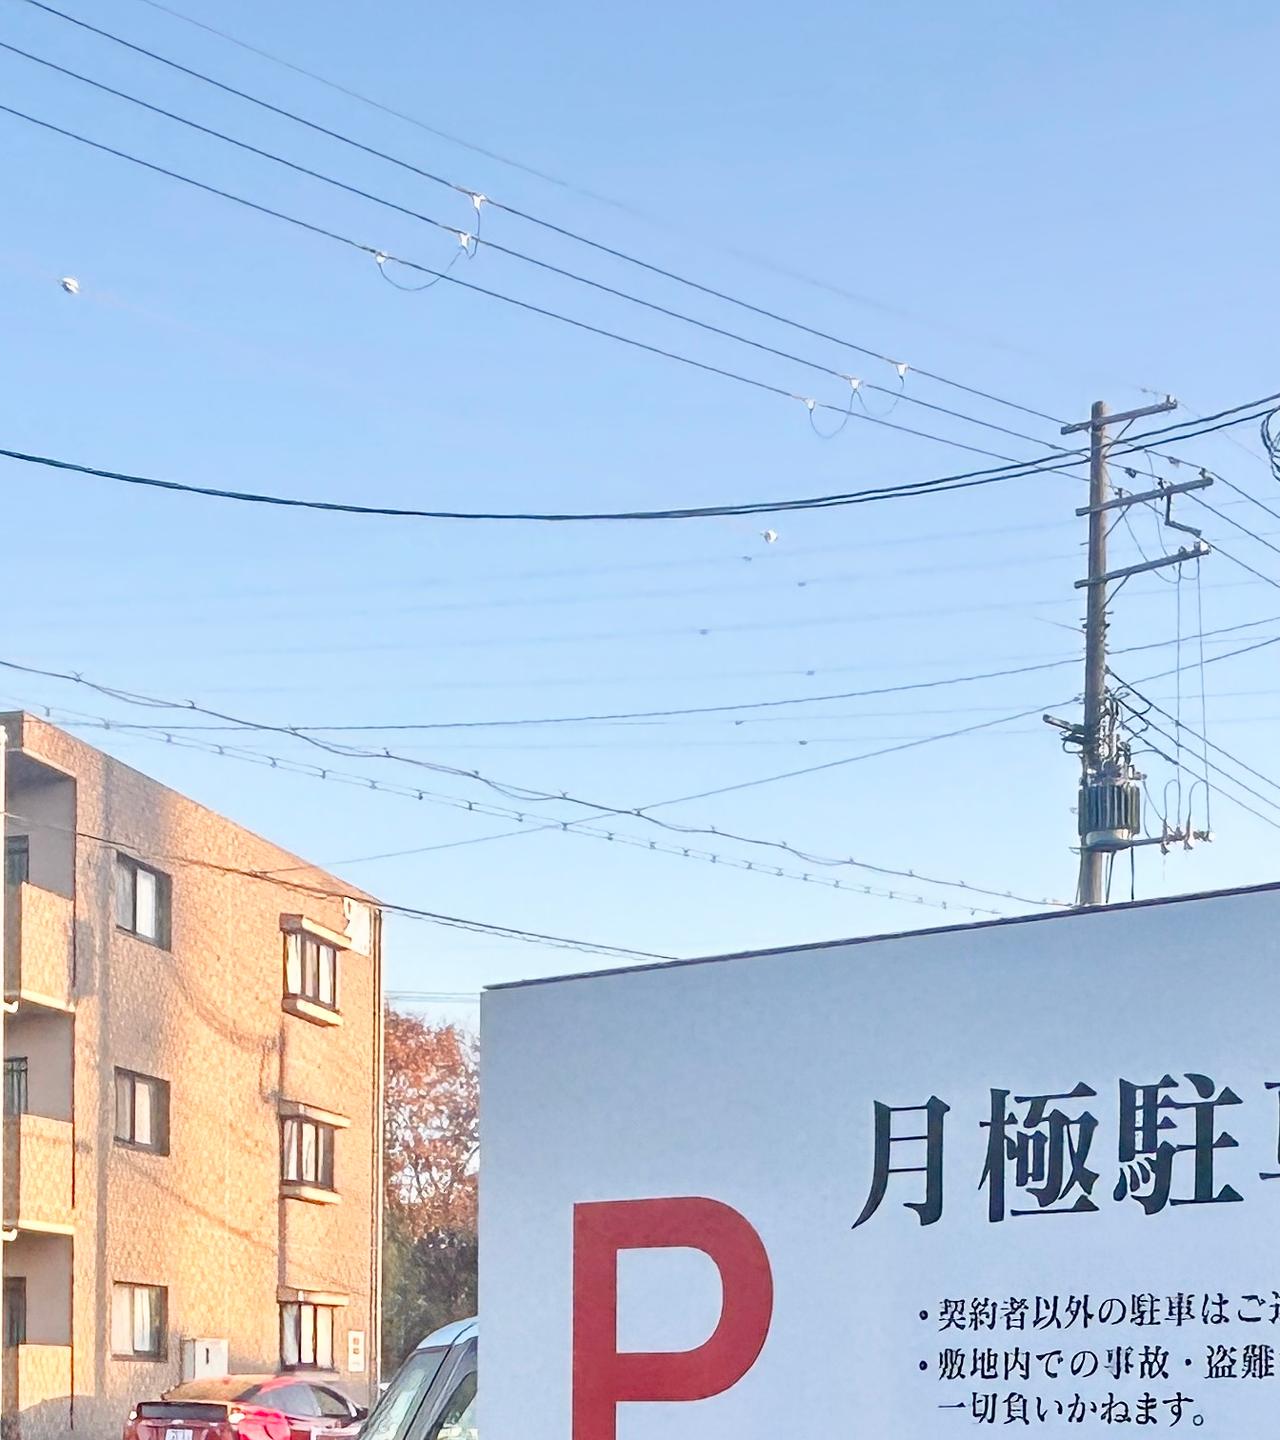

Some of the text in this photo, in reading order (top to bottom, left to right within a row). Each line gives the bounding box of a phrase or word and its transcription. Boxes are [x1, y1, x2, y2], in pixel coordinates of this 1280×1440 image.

[937, 1391, 1205, 1428] 一切負いかねます。
